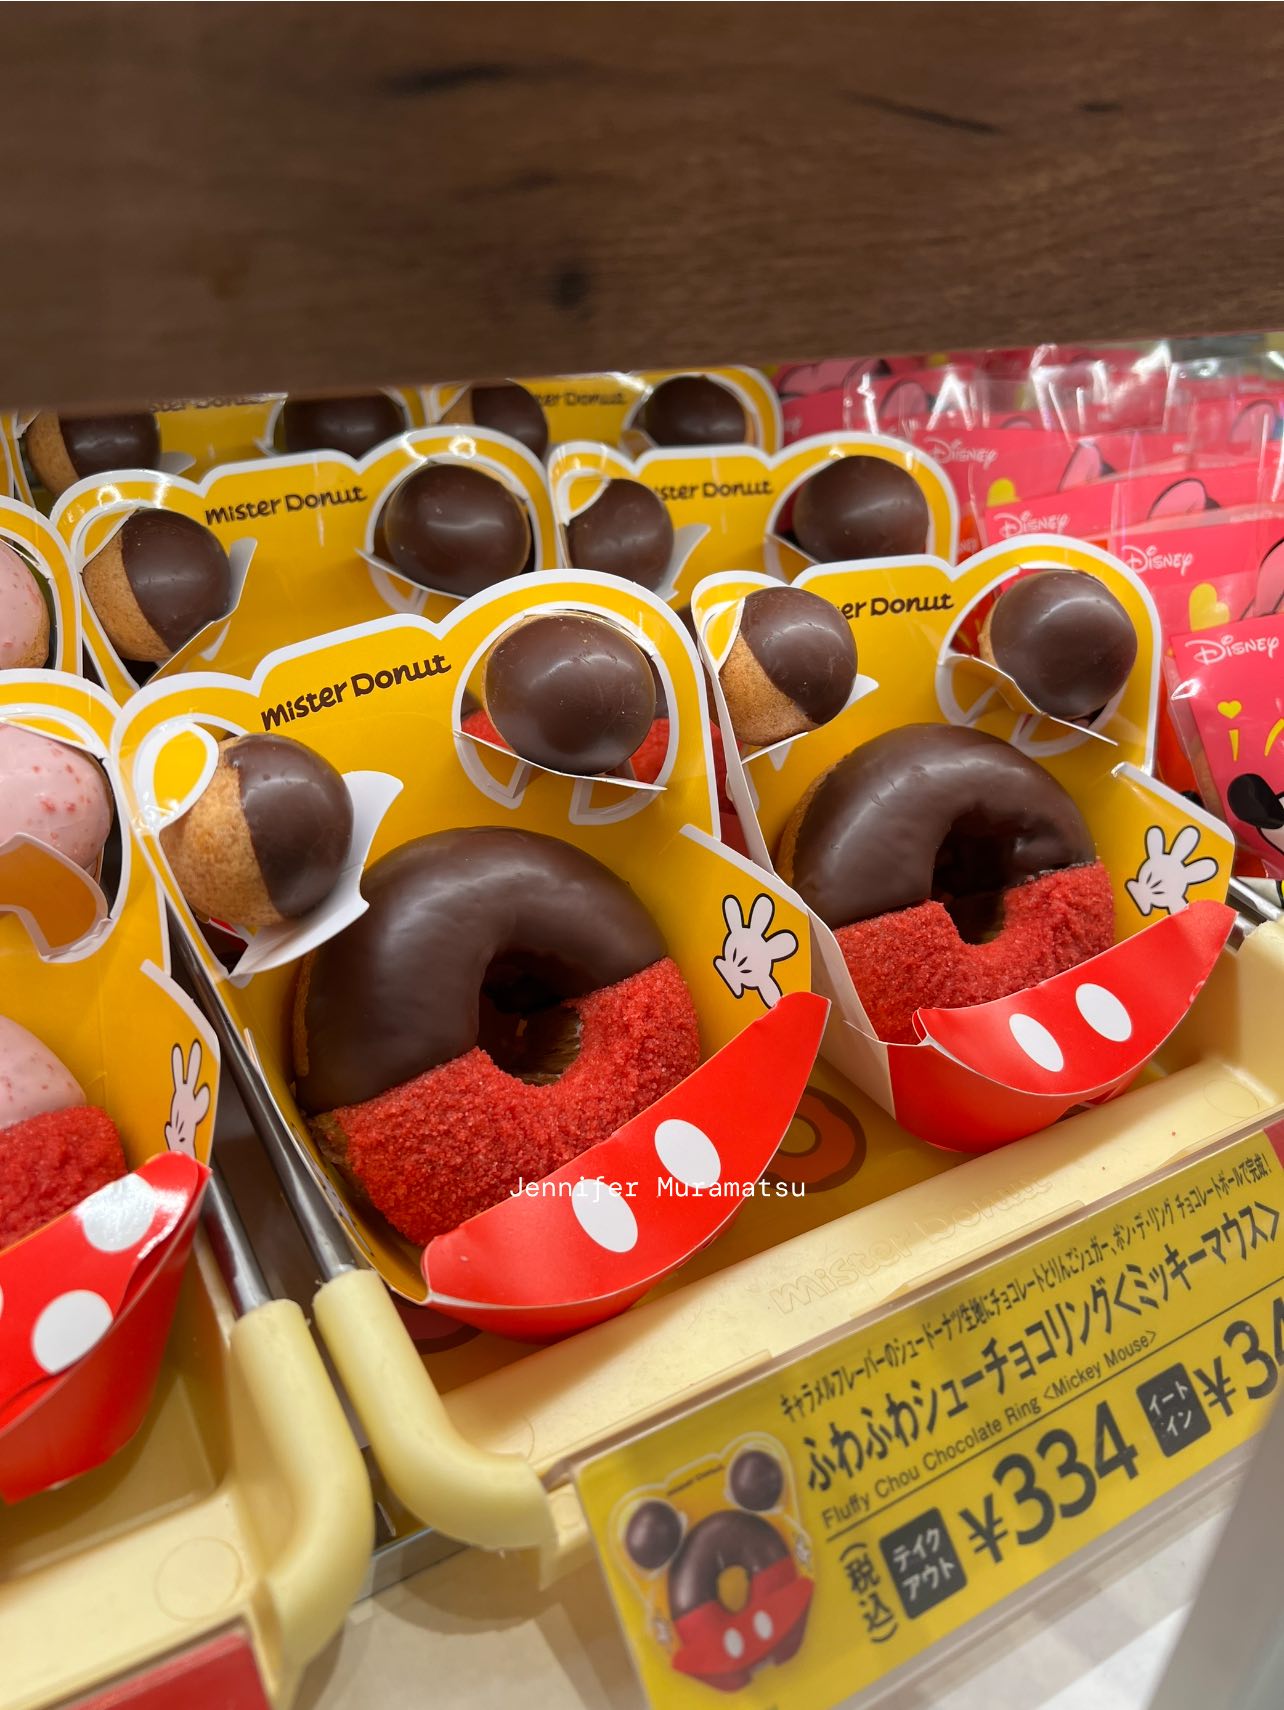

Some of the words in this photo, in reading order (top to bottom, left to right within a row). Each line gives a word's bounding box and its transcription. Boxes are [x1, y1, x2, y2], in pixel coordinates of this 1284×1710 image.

[205, 499, 281, 525] Mister
[284, 486, 368, 512] Donut
[653, 484, 698, 501] ster
[702, 480, 774, 498] Donut
[870, 593, 954, 617] Donut
[261, 681, 347, 731] Mister
[351, 654, 452, 697] Donut
[1193, 1296, 1284, 1418] ¥3
[1149, 1380, 1189, 1416] イート
[1167, 1409, 1192, 1437] イン
[821, 1491, 870, 1528] Fluffy
[874, 1463, 921, 1498] Chou
[922, 1416, 1003, 1472] Chocolate
[1004, 1397, 1042, 1425] Ring
[958, 1400, 1139, 1564] ¥334
[892, 1527, 940, 1572] テイク
[902, 1558, 955, 1601] アウト
